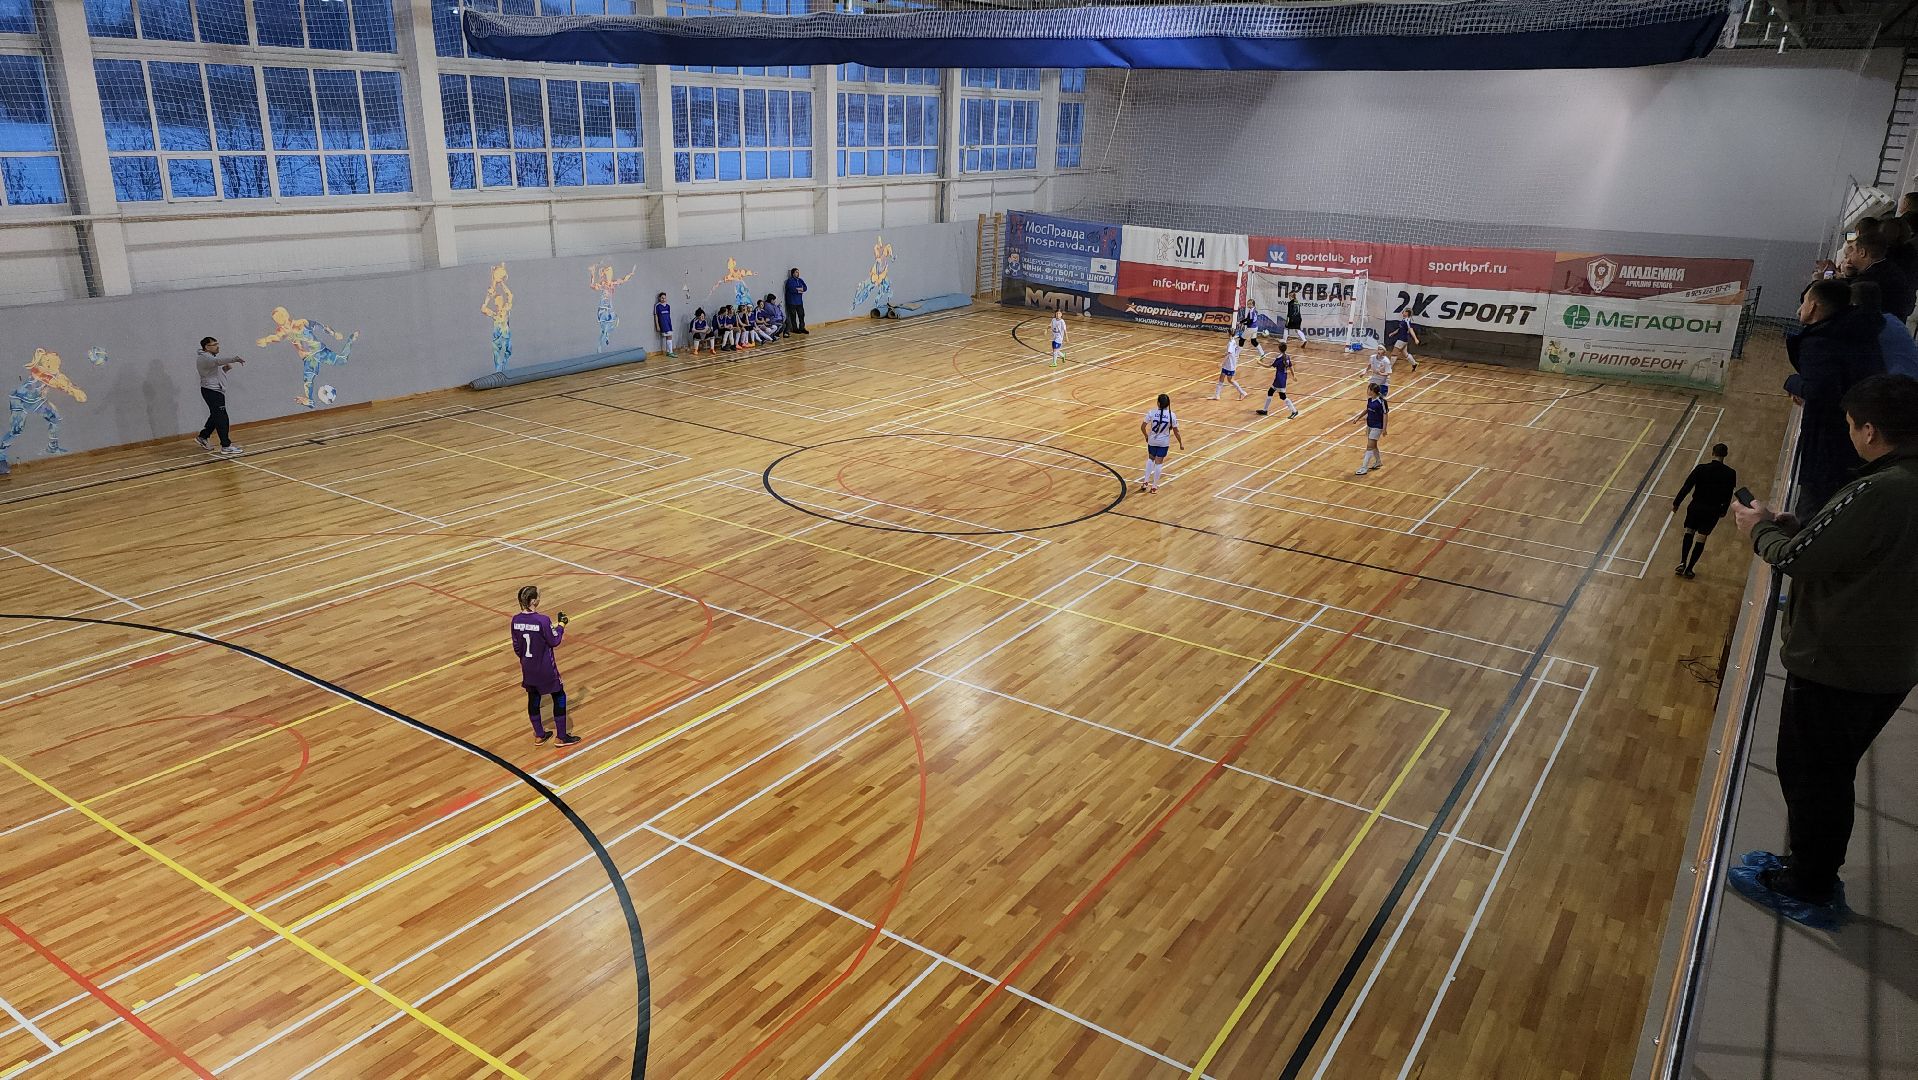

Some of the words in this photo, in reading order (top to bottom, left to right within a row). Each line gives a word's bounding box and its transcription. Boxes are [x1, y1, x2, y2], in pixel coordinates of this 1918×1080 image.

[1025, 221, 1085, 240] МосПравда
[1025, 236, 1100, 253] mospravda.ru
[1175, 235, 1205, 259] SILA
[1428, 260, 1508, 275] sportkprf.ru
[1619, 265, 1686, 282] АКАДЕМИЯ
[1086, 273, 1115, 283] ШКОЛУ
[1152, 277, 1210, 293] mfc-kprf.ru
[1203, 313, 1231, 323] PRO
[1438, 300, 1537, 325] SPORT
[1595, 310, 1722, 334] МЕГАФОН
[1580, 351, 1685, 370] ГРИППФЕРОН
[1152, 420, 1169, 434] 27
[522, 633, 533, 658] 1
